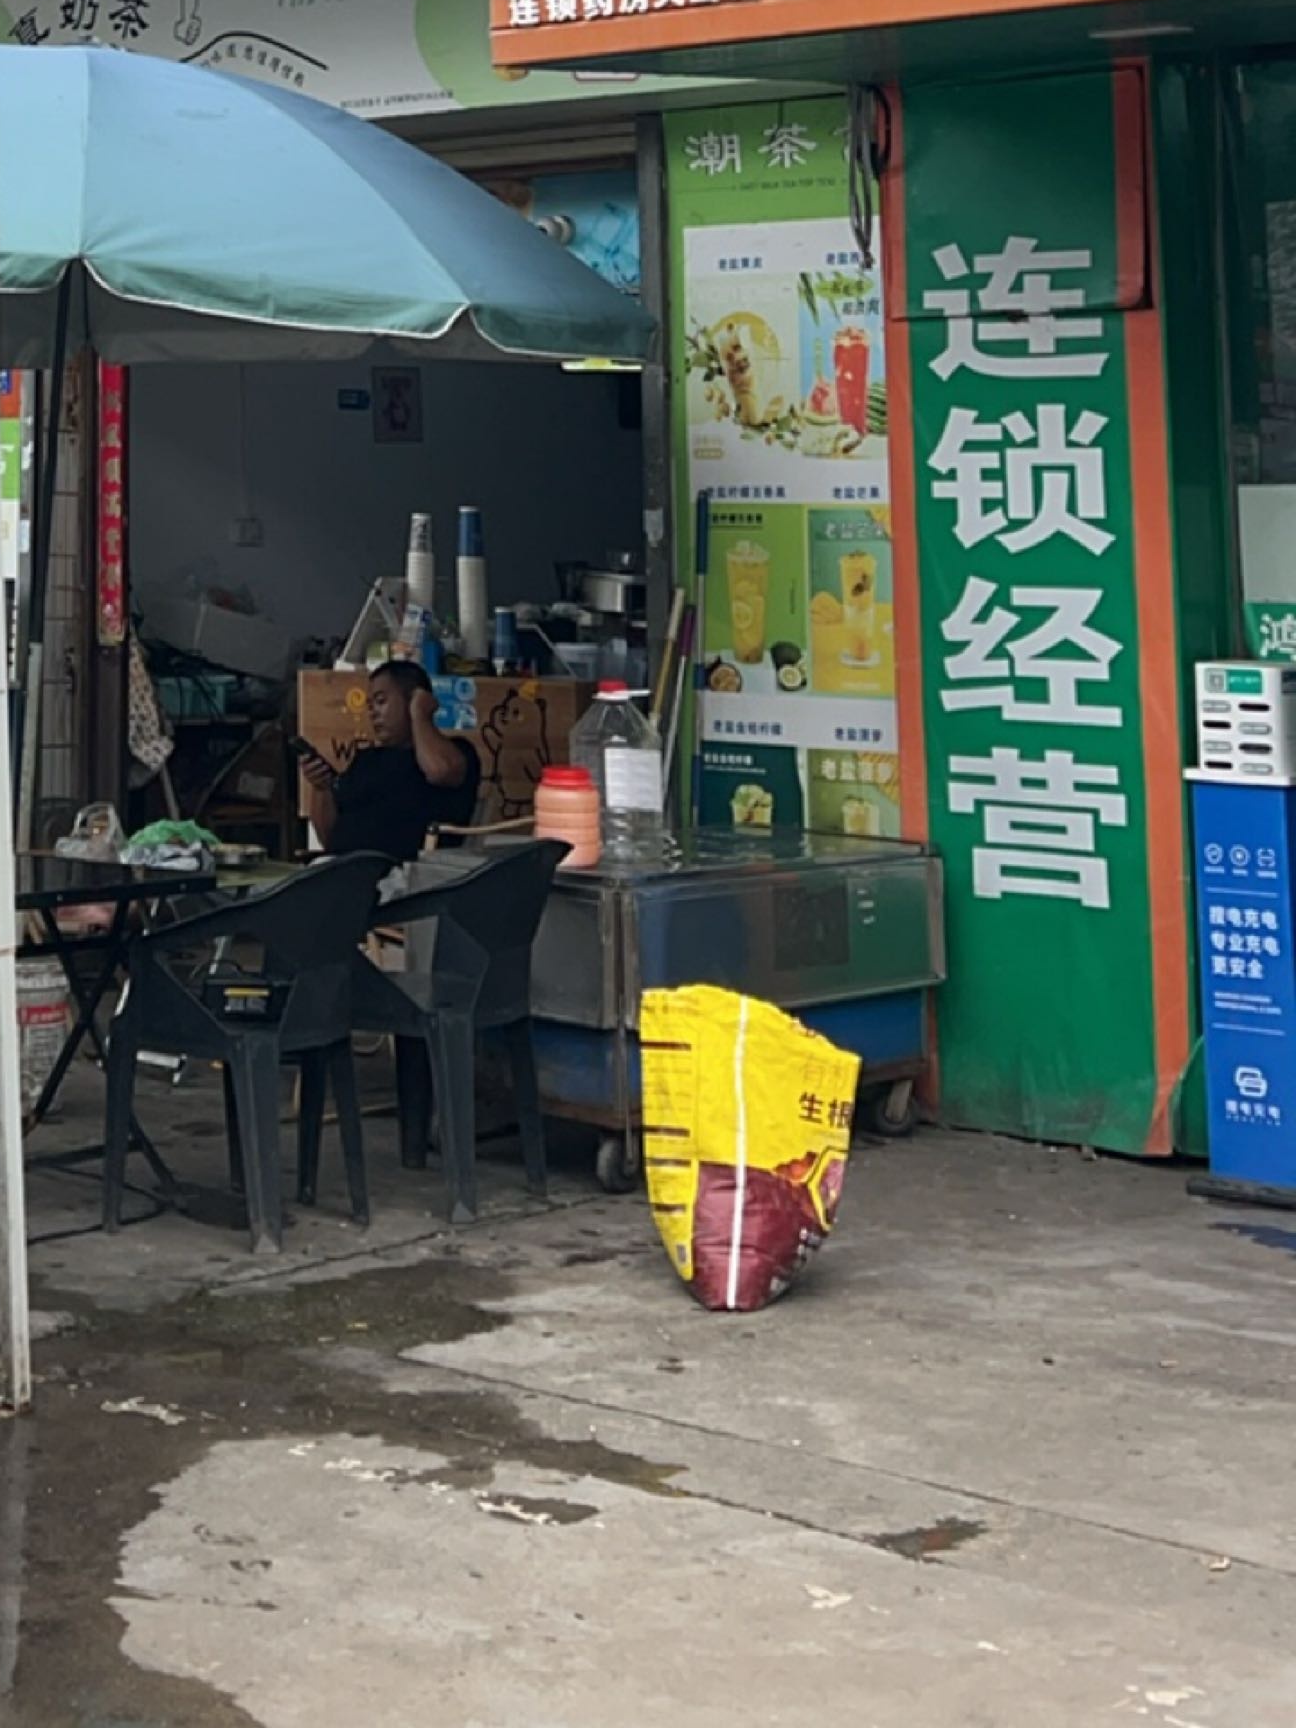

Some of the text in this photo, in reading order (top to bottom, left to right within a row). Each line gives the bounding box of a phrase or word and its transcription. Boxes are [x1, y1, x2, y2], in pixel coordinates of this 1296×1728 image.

[684, 123, 852, 176] 潮茶
[922, 234, 1128, 911] 连锁经营
